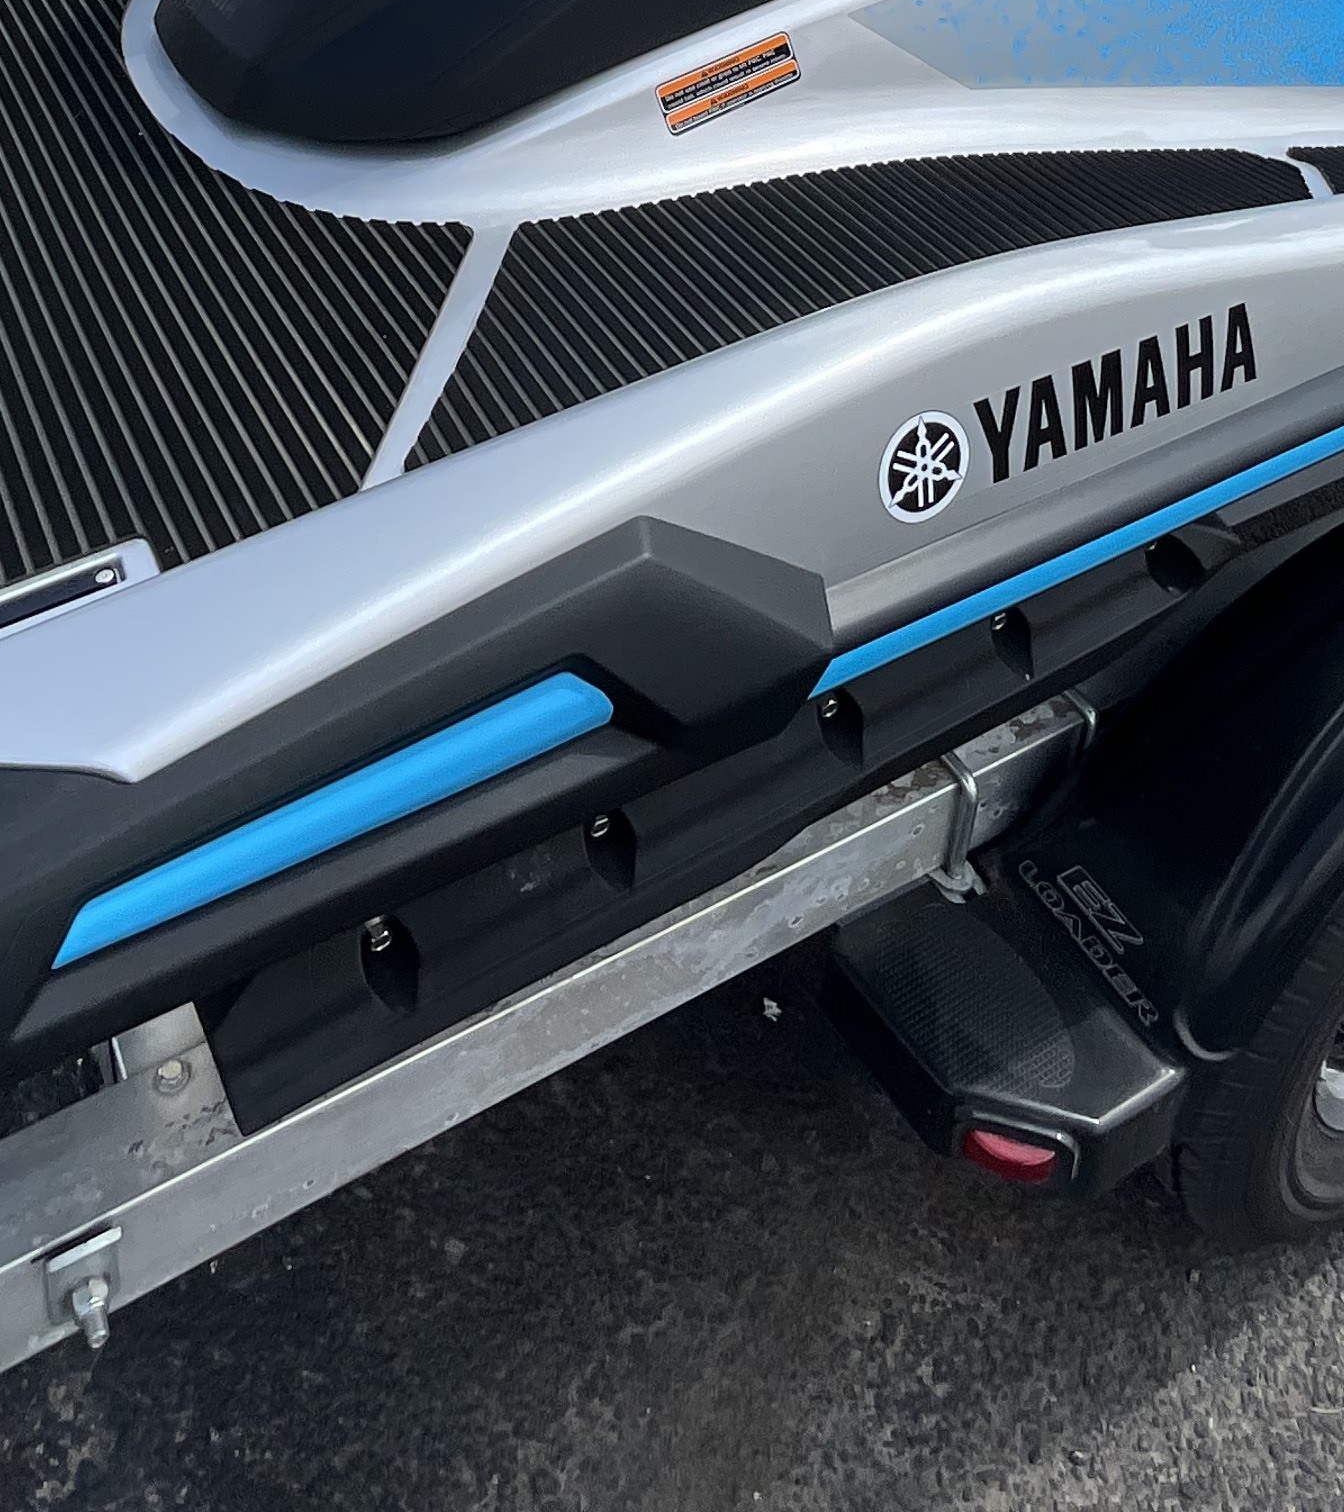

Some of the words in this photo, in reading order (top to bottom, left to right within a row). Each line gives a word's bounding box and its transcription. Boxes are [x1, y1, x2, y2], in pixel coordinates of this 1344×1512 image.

[973, 302, 1257, 484] YAMAHA
[1018, 859, 1159, 1026] LOADER
[1057, 865, 1144, 955] EZ
